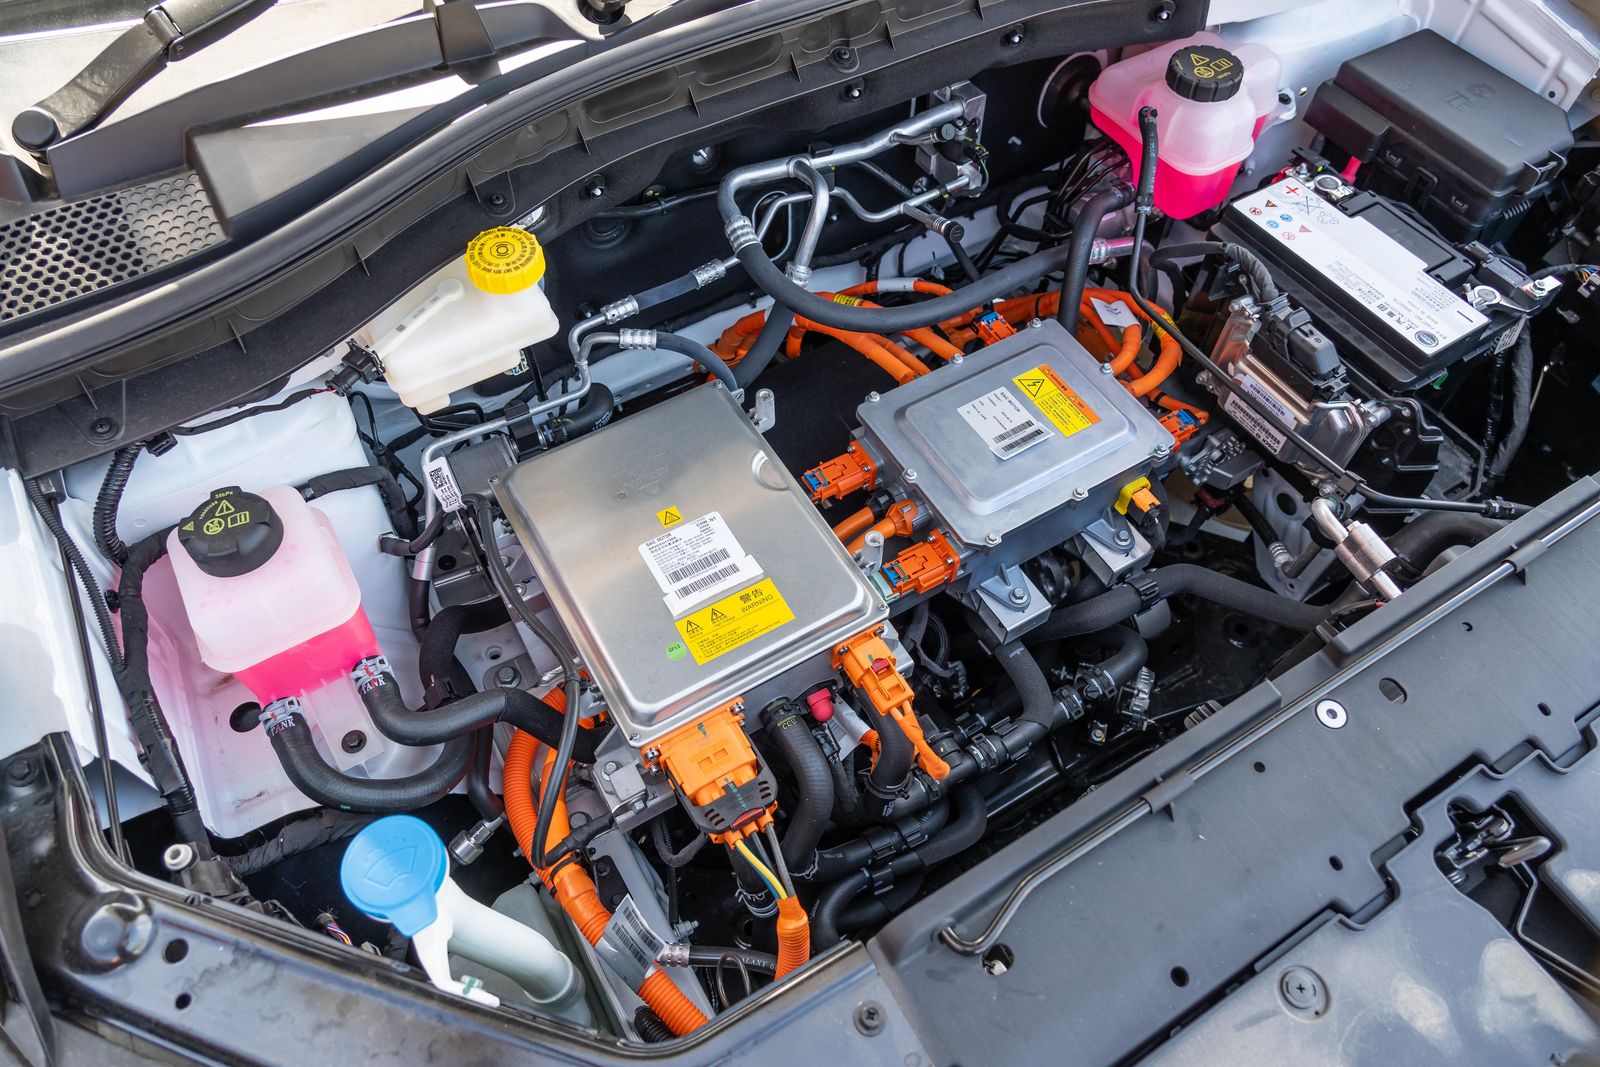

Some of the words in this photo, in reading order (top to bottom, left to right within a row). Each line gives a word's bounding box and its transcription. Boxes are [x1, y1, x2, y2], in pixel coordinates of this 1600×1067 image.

[739, 588, 763, 604] 警告
[740, 594, 774, 613] WARNING
[361, 677, 386, 695] TANK
[271, 719, 296, 737] TANK
[782, 718, 797, 730] CCU
